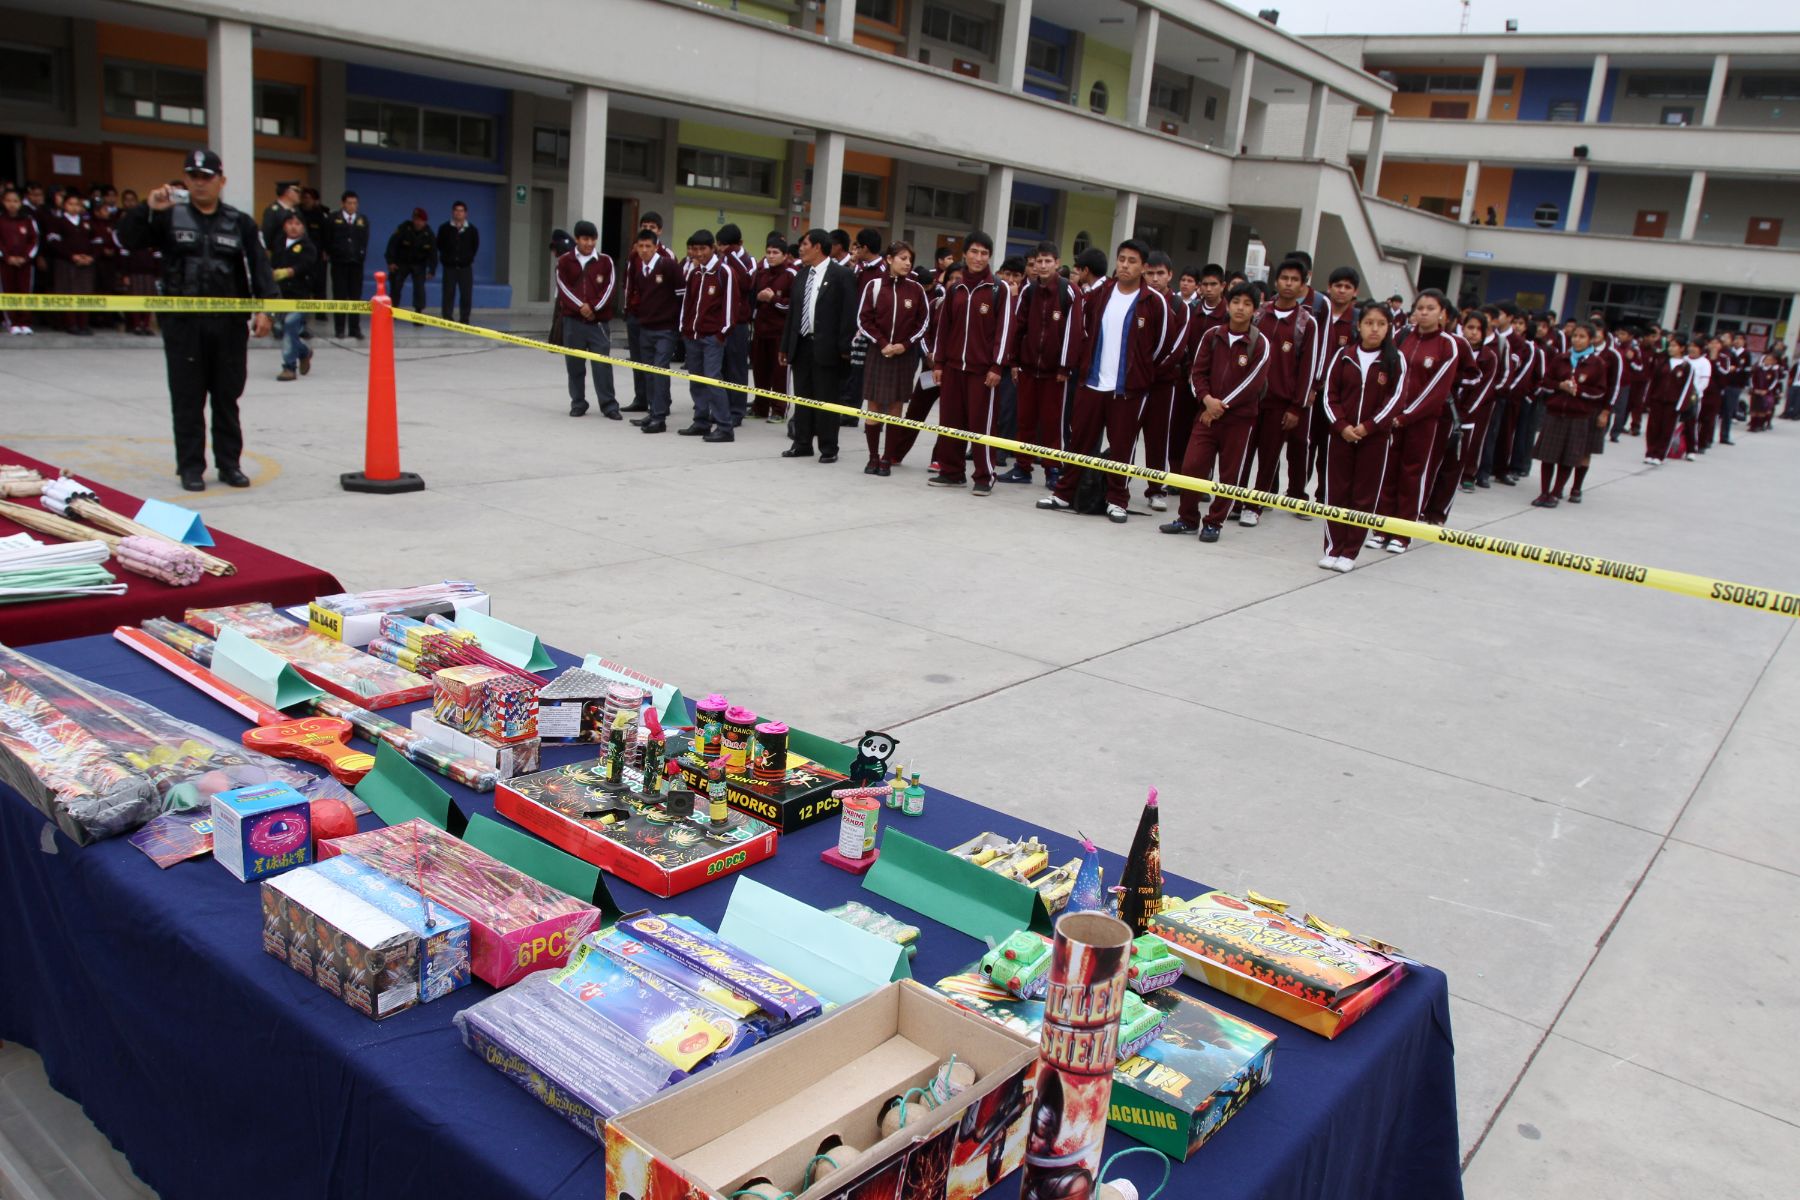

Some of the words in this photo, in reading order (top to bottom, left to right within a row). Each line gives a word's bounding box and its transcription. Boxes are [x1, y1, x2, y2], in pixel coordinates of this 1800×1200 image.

[1130, 465, 1168, 481] CRIME
[1211, 482, 1254, 499] CROSS
[1253, 489, 1280, 505] NOT
[1280, 496, 1298, 509] DO
[1300, 499, 1341, 518] SCENE
[1343, 509, 1387, 528] CRIME
[1438, 528, 1488, 549] CROSS
[1487, 537, 1520, 556] NOT
[1521, 544, 1543, 560] DO
[1543, 549, 1595, 572] SCENE
[1595, 558, 1649, 583] CRIME
[1711, 582, 1769, 608] CROSS
[798, 803, 813, 821] 12
[816, 796, 840, 813] PCS
[707, 859, 725, 876] 30
[725, 850, 747, 869] PCS
[1044, 976, 1128, 1024] ILLER
[1117, 1055, 1193, 1099] TAN
